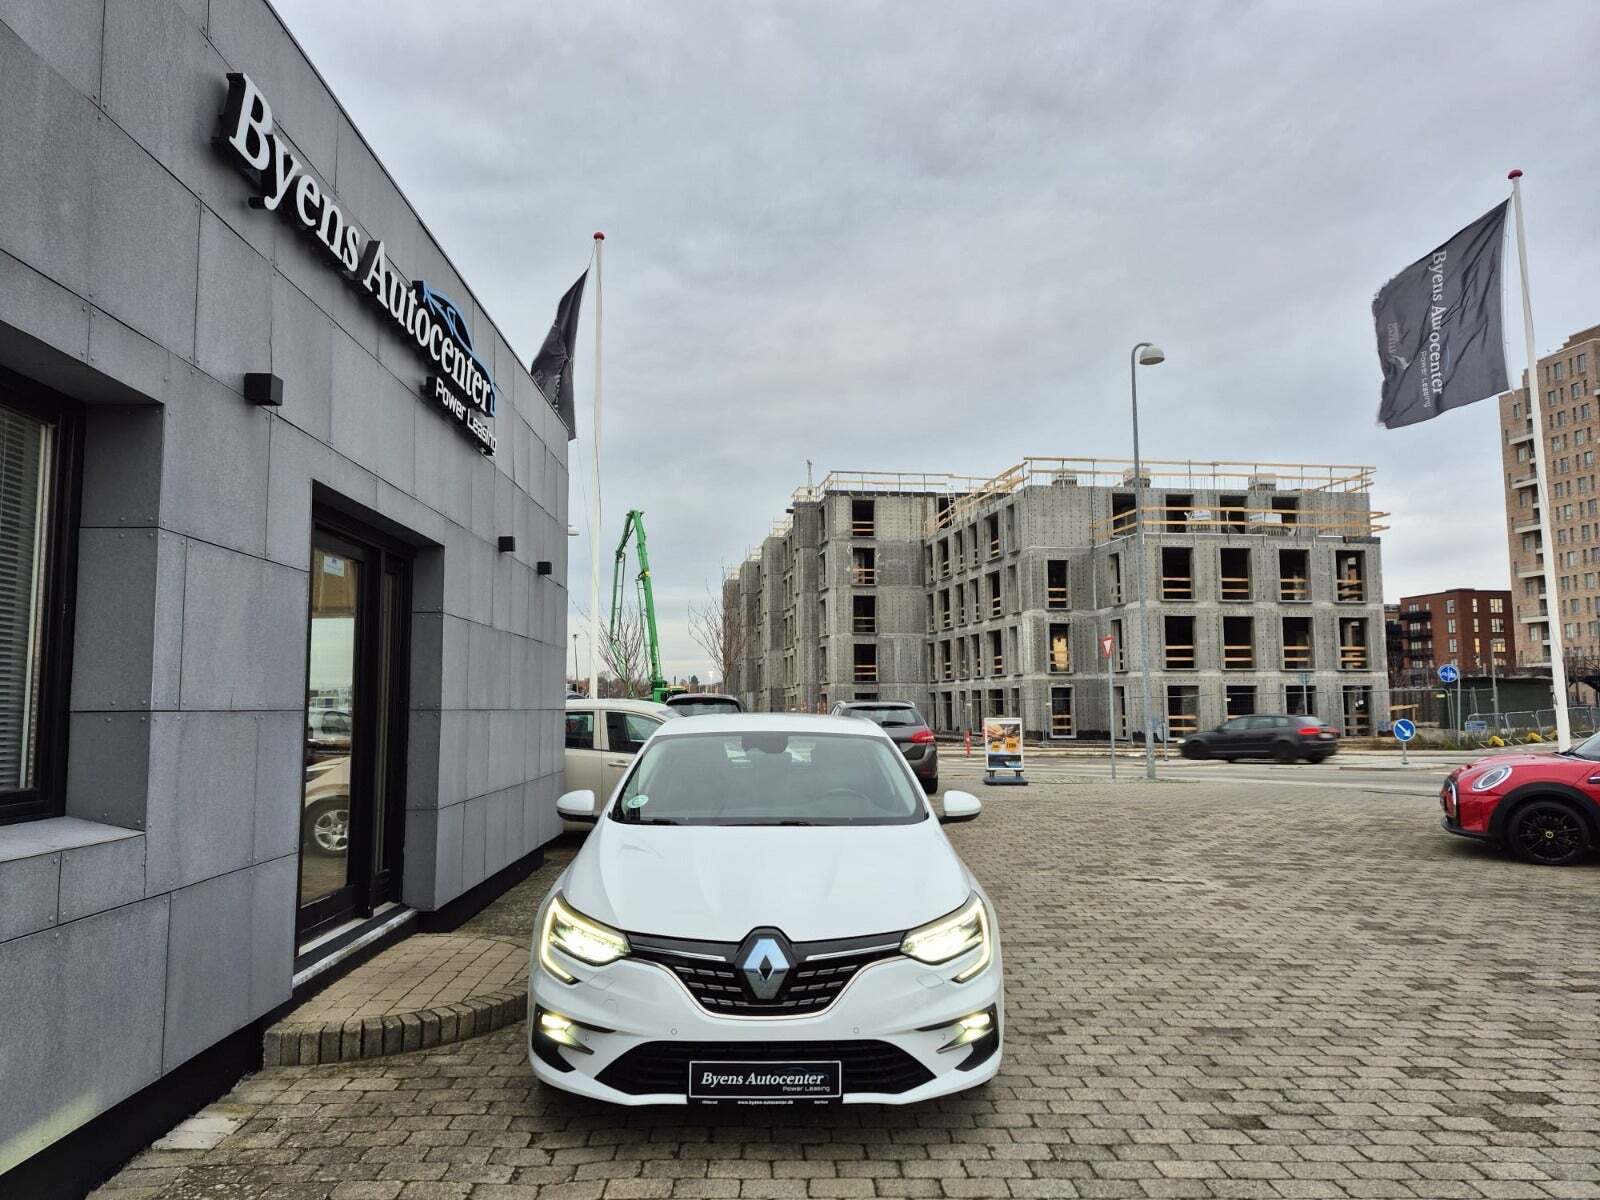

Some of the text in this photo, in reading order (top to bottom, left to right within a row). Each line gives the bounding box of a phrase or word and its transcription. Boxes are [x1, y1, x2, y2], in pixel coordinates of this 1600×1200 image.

[229, 73, 491, 412] Byens Autocenter
[1429, 250, 1447, 301] Byens
[436, 377, 497, 456] Power Leasing
[701, 1072, 825, 1088] Byens Autocenter
